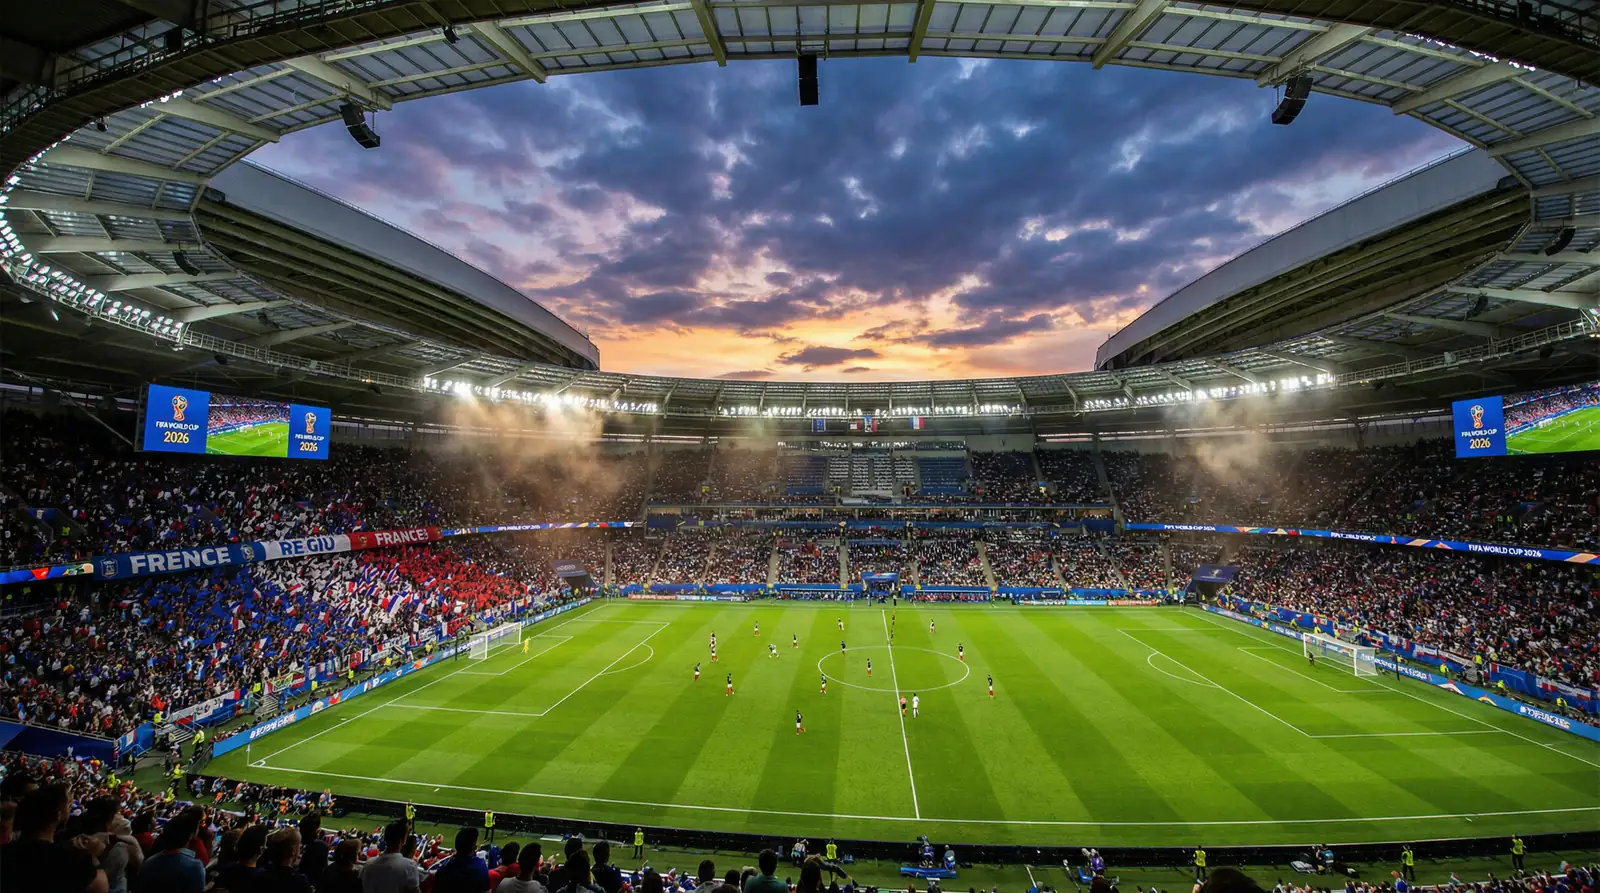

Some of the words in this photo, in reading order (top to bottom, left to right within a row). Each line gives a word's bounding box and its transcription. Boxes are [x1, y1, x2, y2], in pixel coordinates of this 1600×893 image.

[164, 431, 190, 444] 2026
[1469, 437, 1491, 449] 2026
[300, 441, 318, 452] 2026
[1468, 544, 1483, 552] FIFA
[1483, 545, 1508, 555] WORLD
[1508, 547, 1523, 556] CUP
[1524, 549, 1542, 558] 2026
[129, 546, 231, 574] FRENCE
